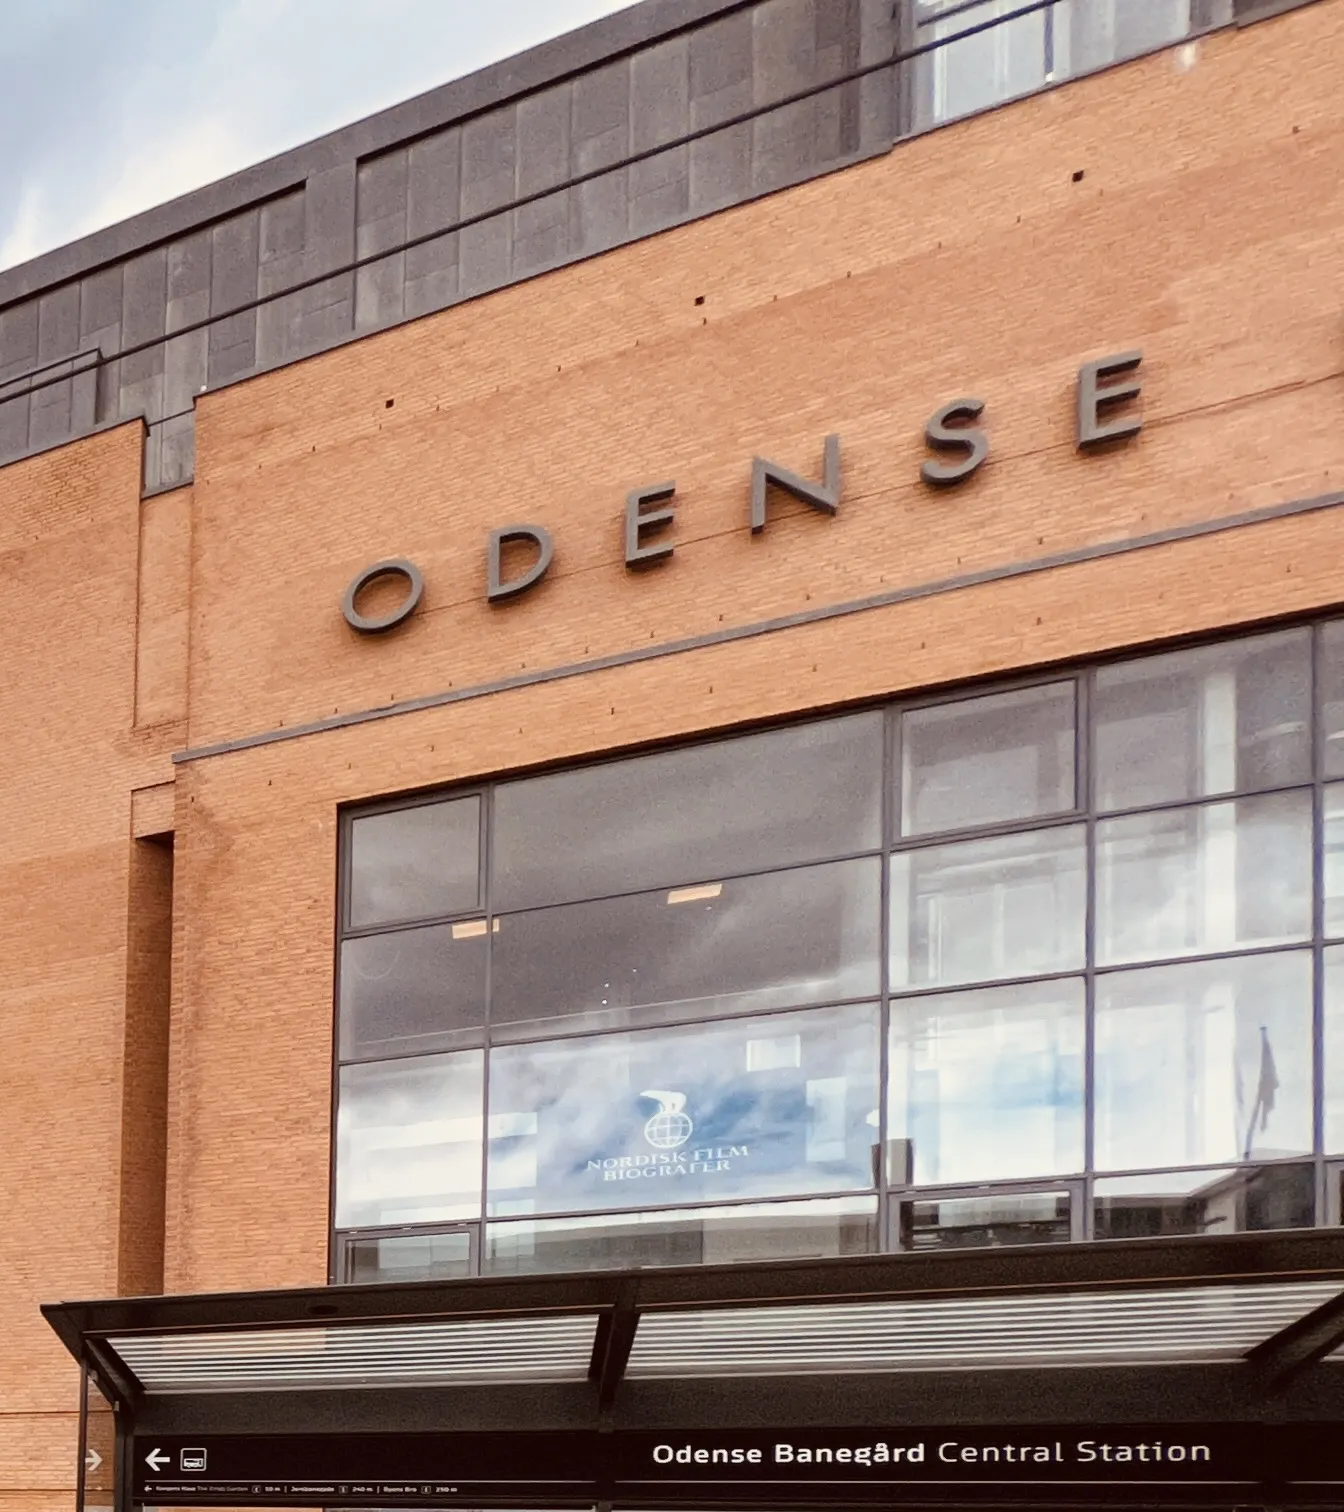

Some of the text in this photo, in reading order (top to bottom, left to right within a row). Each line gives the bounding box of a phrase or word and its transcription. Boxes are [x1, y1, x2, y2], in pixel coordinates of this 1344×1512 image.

[341, 348, 1145, 636] ODENSE
[585, 1145, 749, 1172] NORDISK FILM
[603, 1160, 731, 1182] BIOGRAFER
[652, 1440, 1211, 1467] Odense Banegård Central Station
